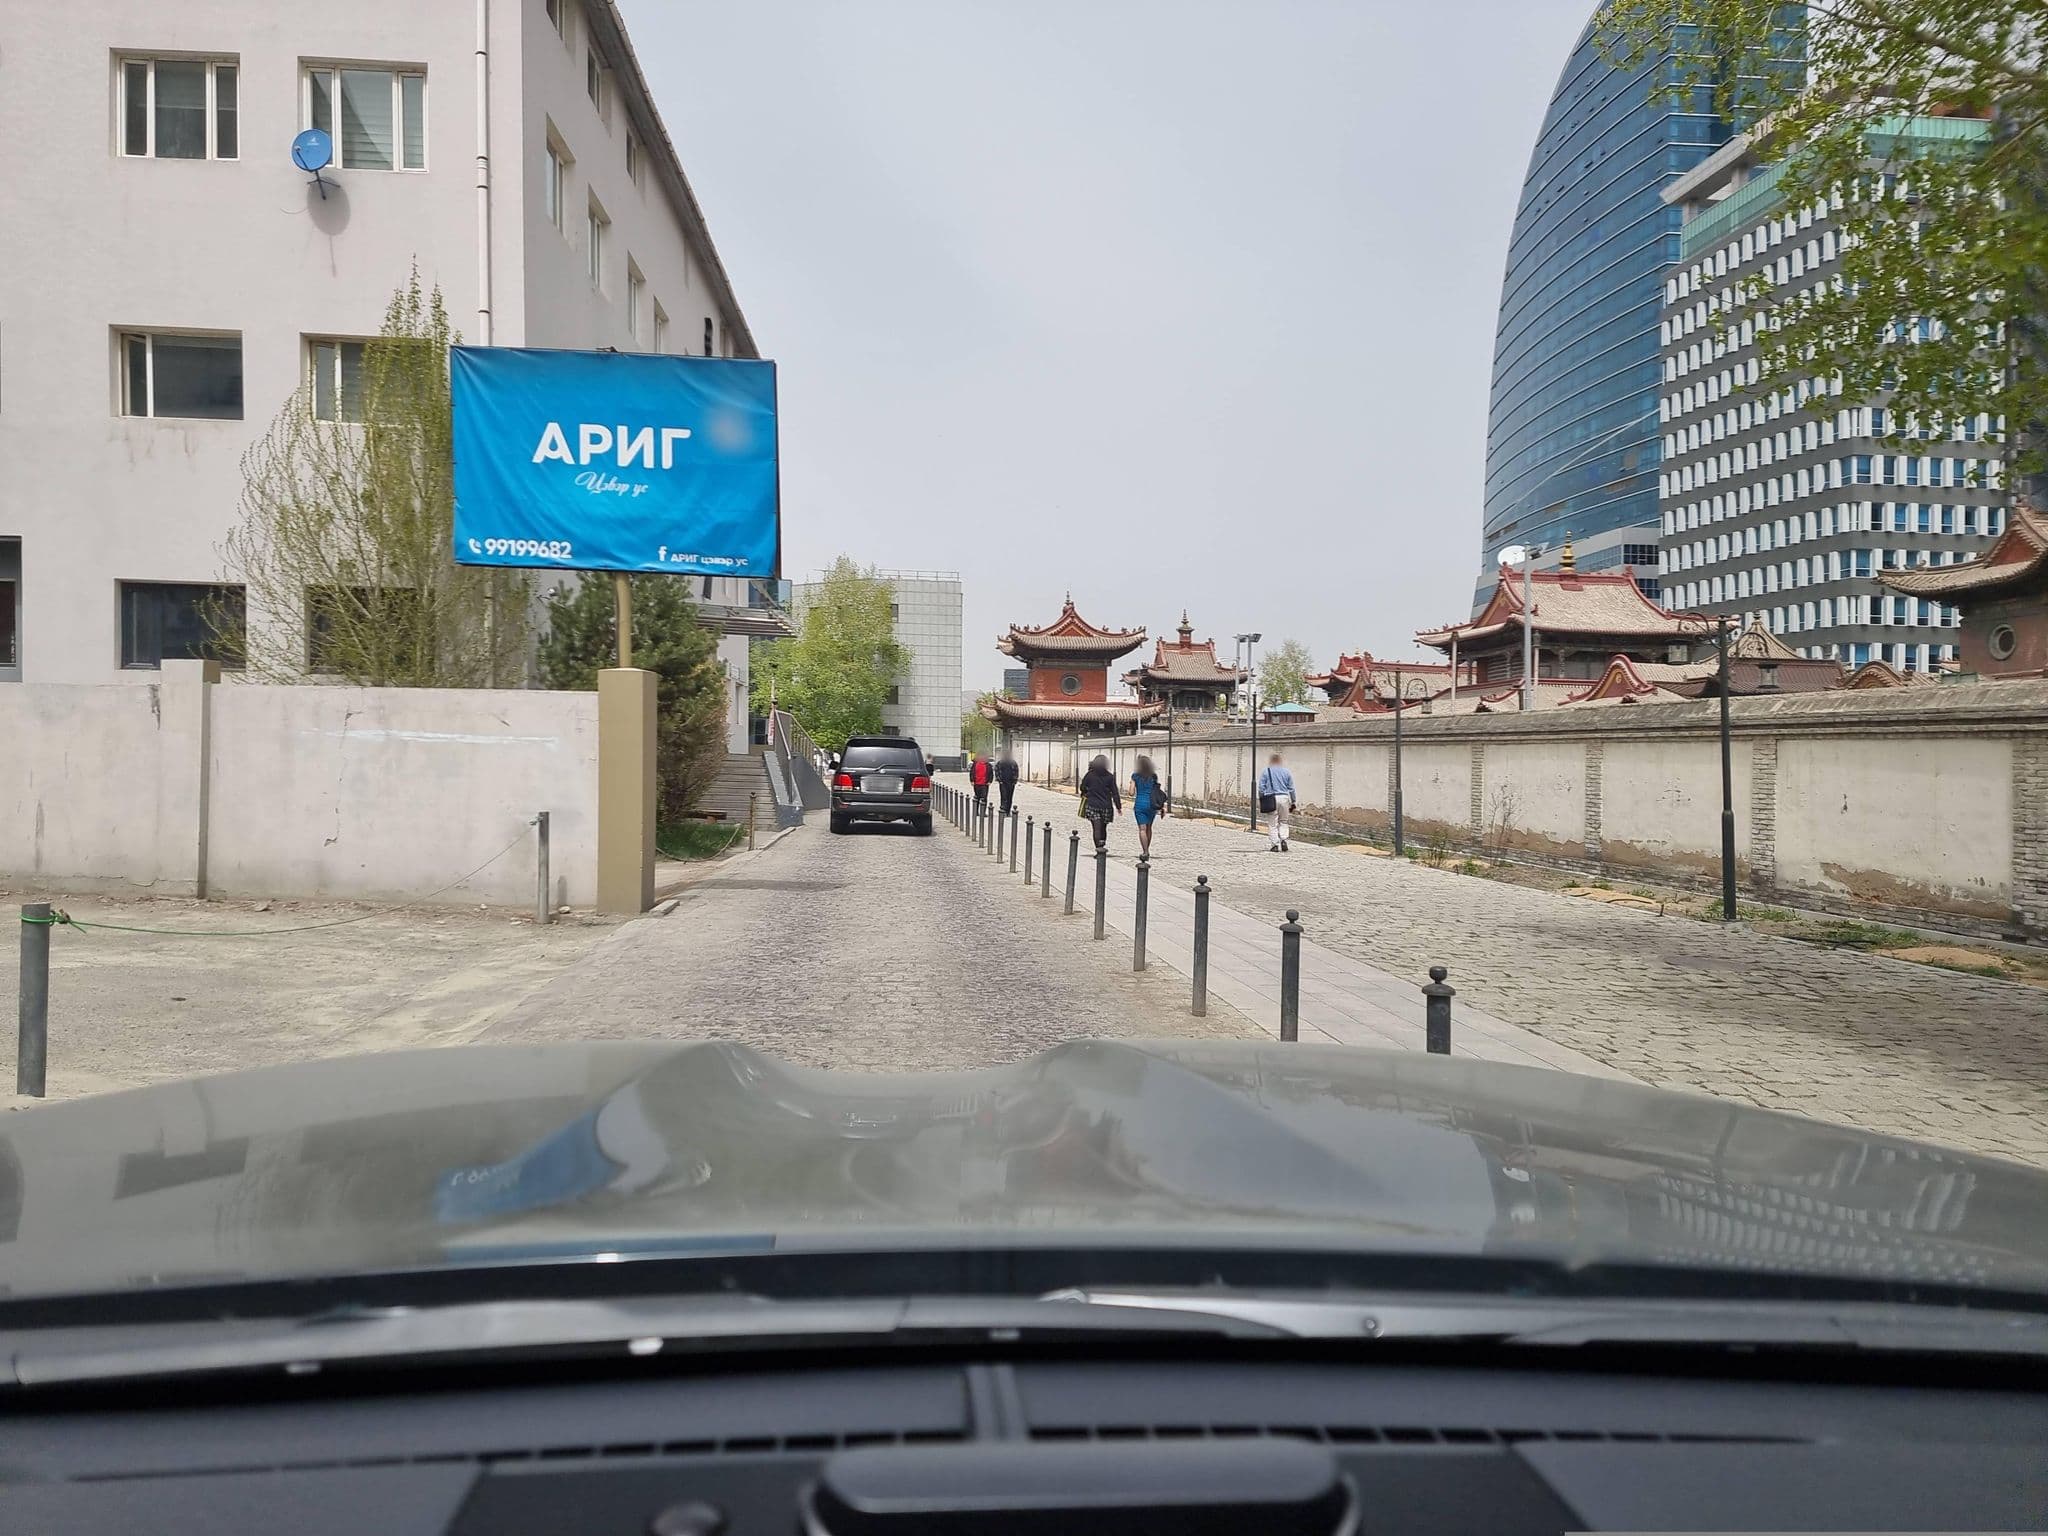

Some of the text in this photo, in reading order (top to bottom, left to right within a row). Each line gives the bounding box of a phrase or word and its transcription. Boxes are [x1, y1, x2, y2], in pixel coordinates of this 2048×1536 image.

[532, 422, 691, 469] АРИГ
[631, 484, 649, 497] ус
[485, 538, 572, 559] 99199682
[670, 553, 699, 563] АРИГ
[735, 558, 748, 566] ус
